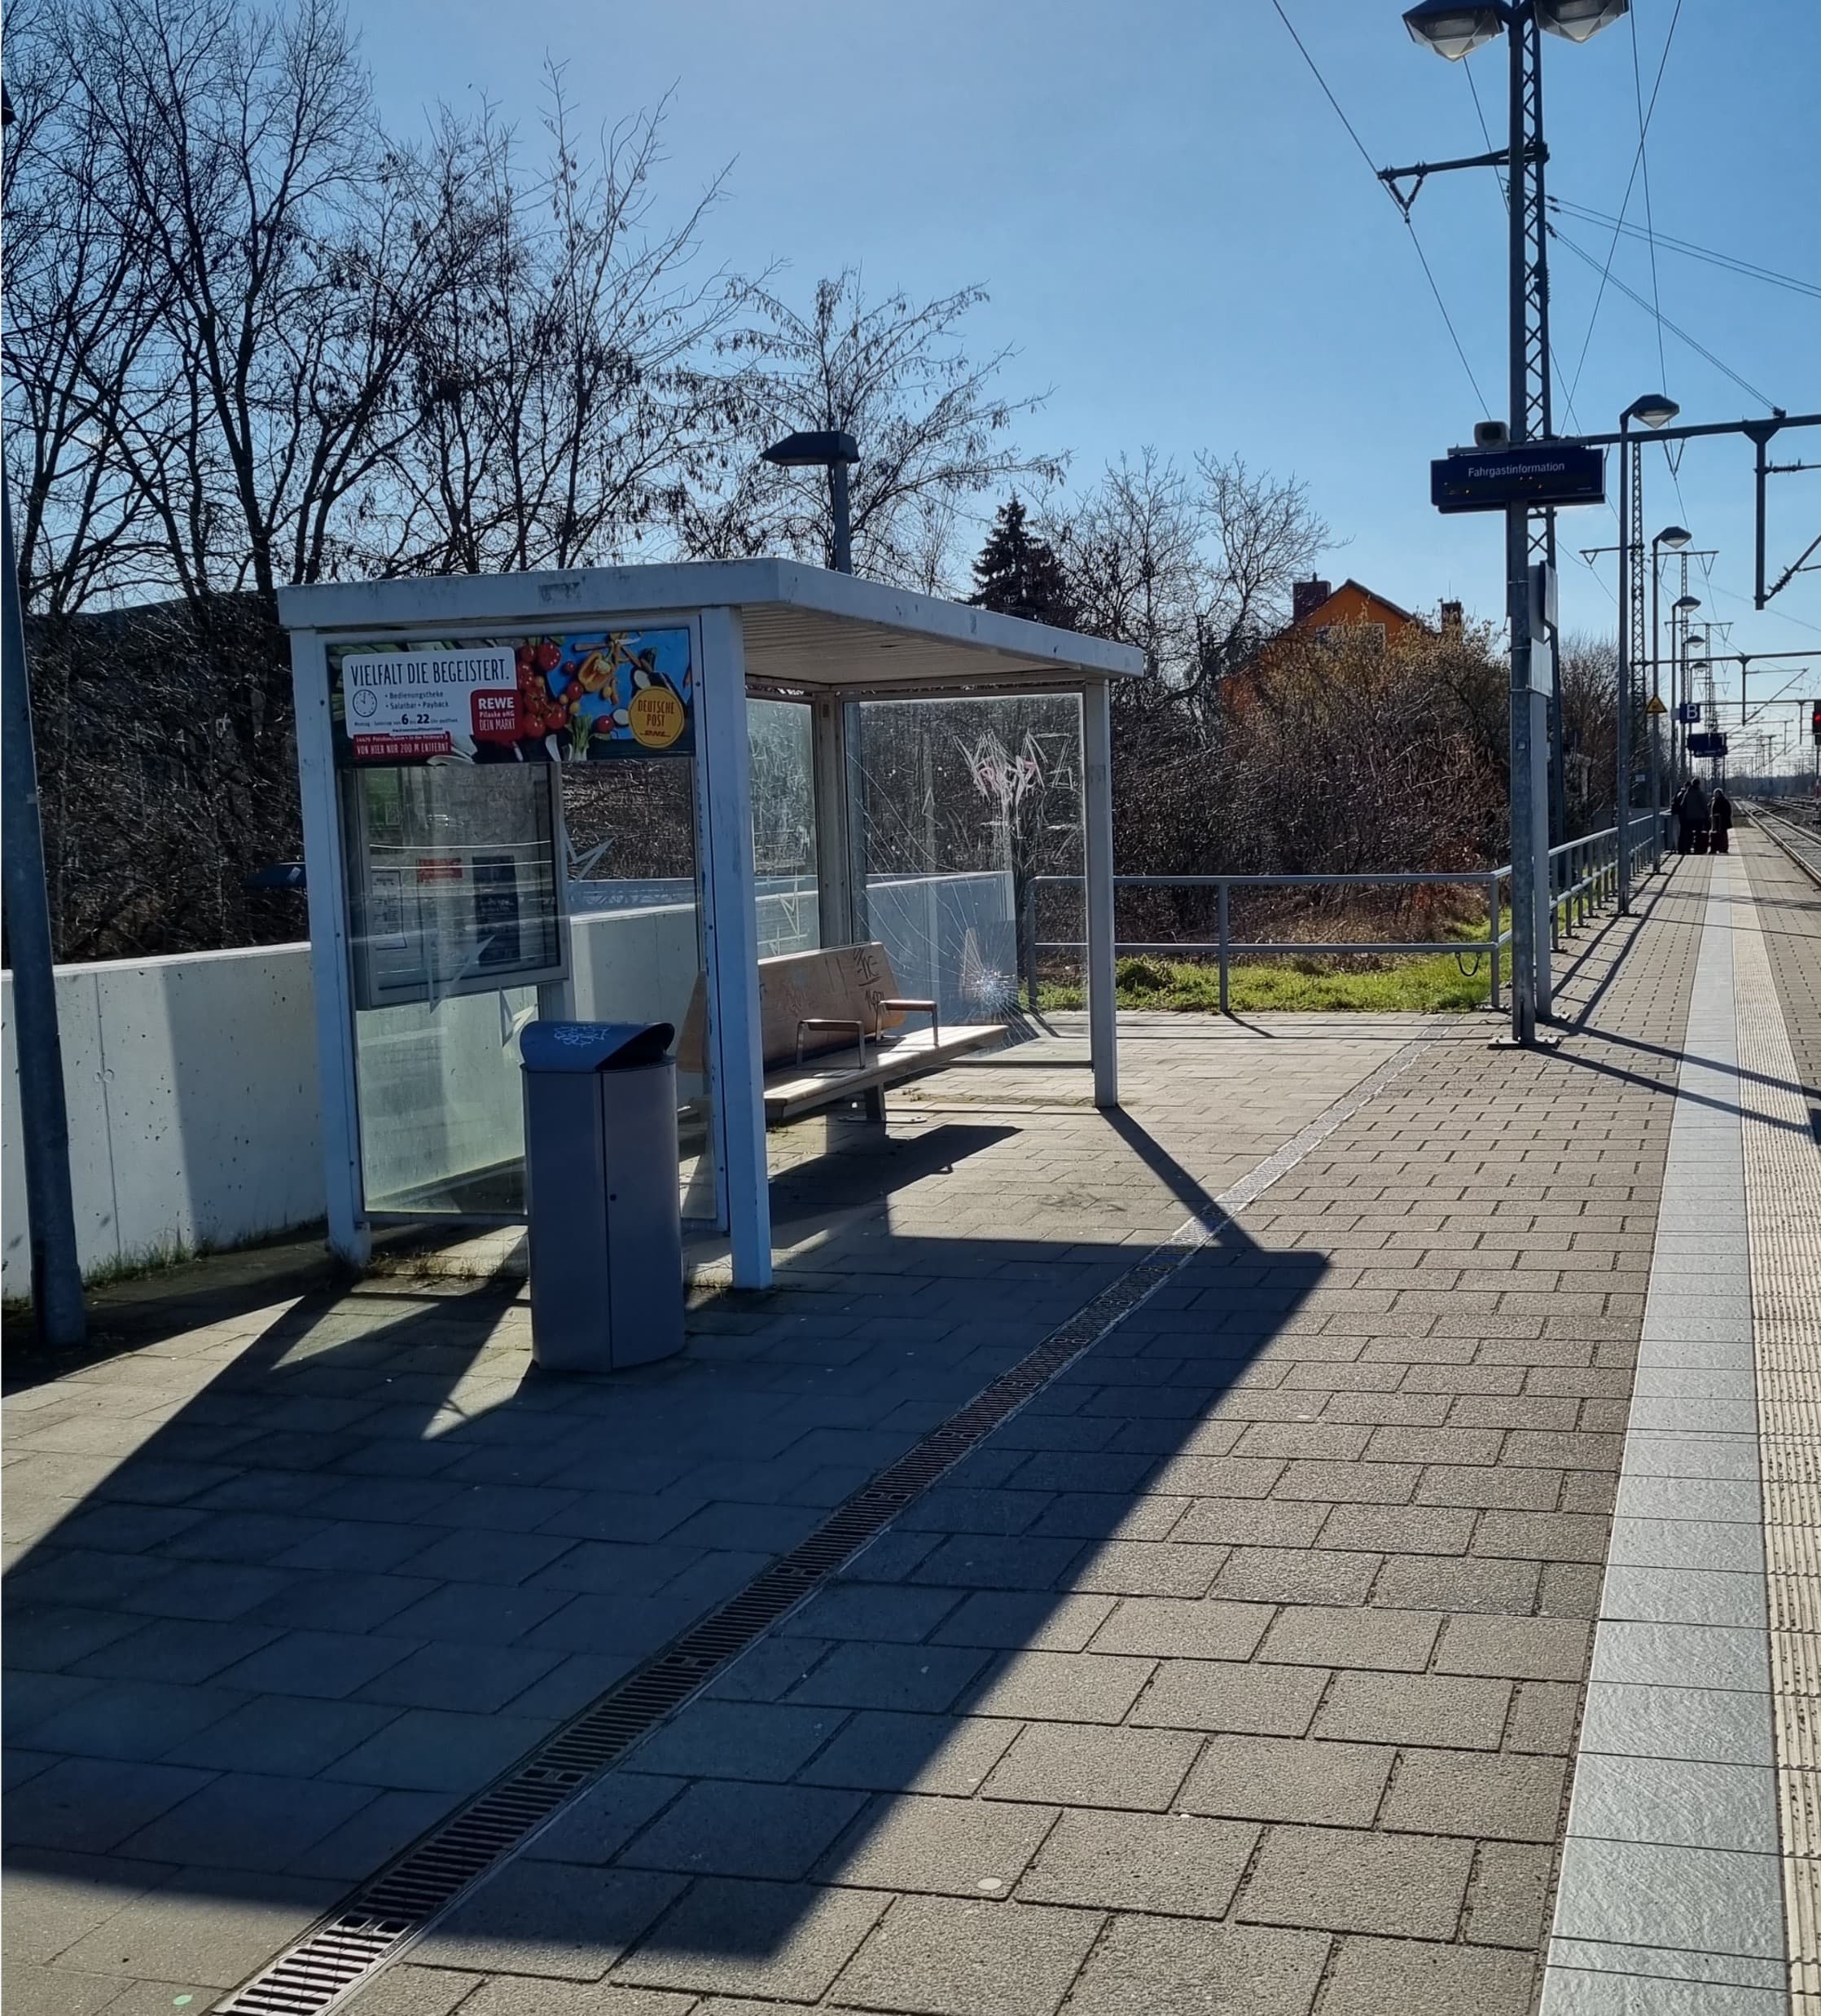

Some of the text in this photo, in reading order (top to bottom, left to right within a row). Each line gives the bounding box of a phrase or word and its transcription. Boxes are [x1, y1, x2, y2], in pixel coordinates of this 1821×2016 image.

[1468, 462, 1564, 478] Fahrgastinformation
[351, 658, 510, 687] VIELFALT DIE BEGEISTERT.
[478, 696, 515, 709] REWE
[638, 700, 674, 714] DEUTSCHE
[1687, 704, 1699, 719] B
[401, 714, 409, 725] 6
[416, 714, 430, 724] 22
[479, 718, 515, 731] DEIN MARKT
[647, 714, 665, 727] POST
[357, 742, 449, 755] VON HIER NUR 200 M ENTFERNT
